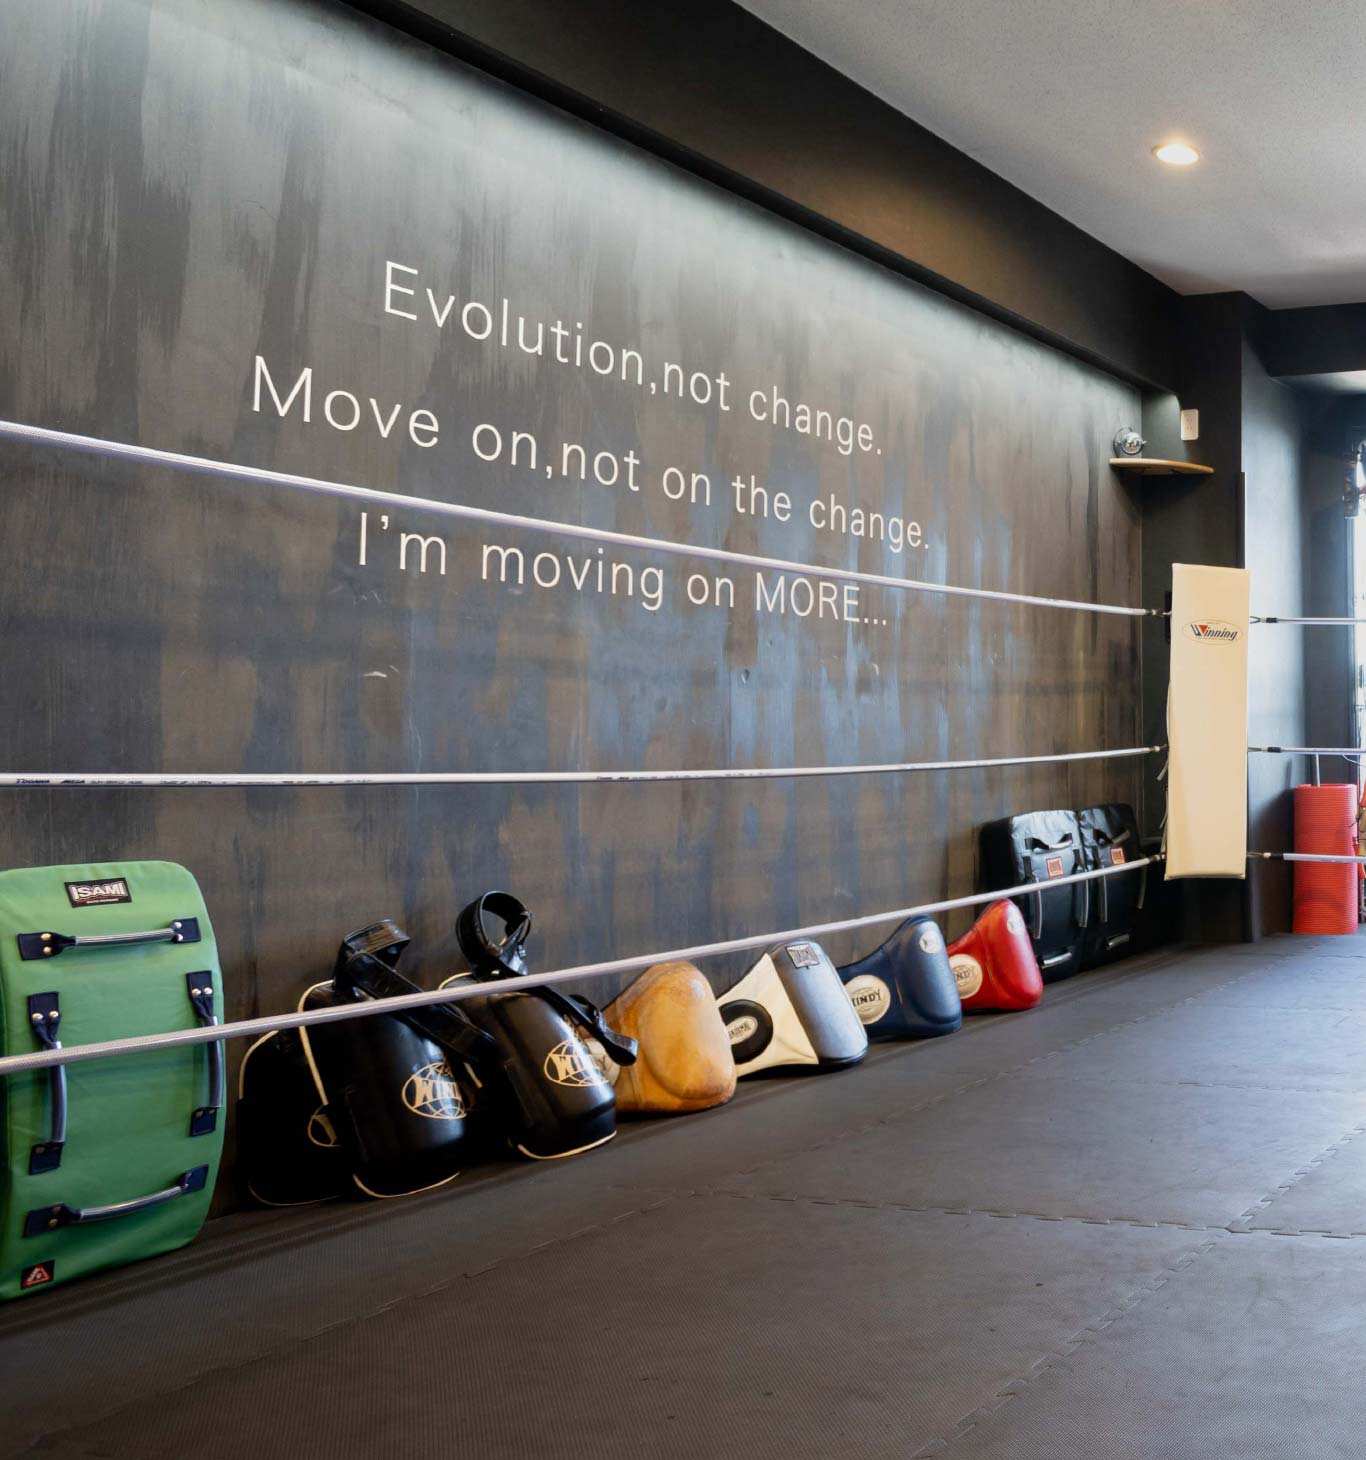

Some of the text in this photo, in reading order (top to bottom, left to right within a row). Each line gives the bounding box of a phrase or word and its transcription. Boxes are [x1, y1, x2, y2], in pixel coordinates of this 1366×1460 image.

[252, 355, 439, 448] Move
[662, 467, 711, 506] on
[731, 474, 792, 522] the
[809, 493, 930, 554] change.
[749, 385, 883, 456] change.
[359, 511, 888, 626] I'm moving on MORE...
[1190, 623, 1238, 641] Winning
[70, 881, 128, 901] ISAMI
